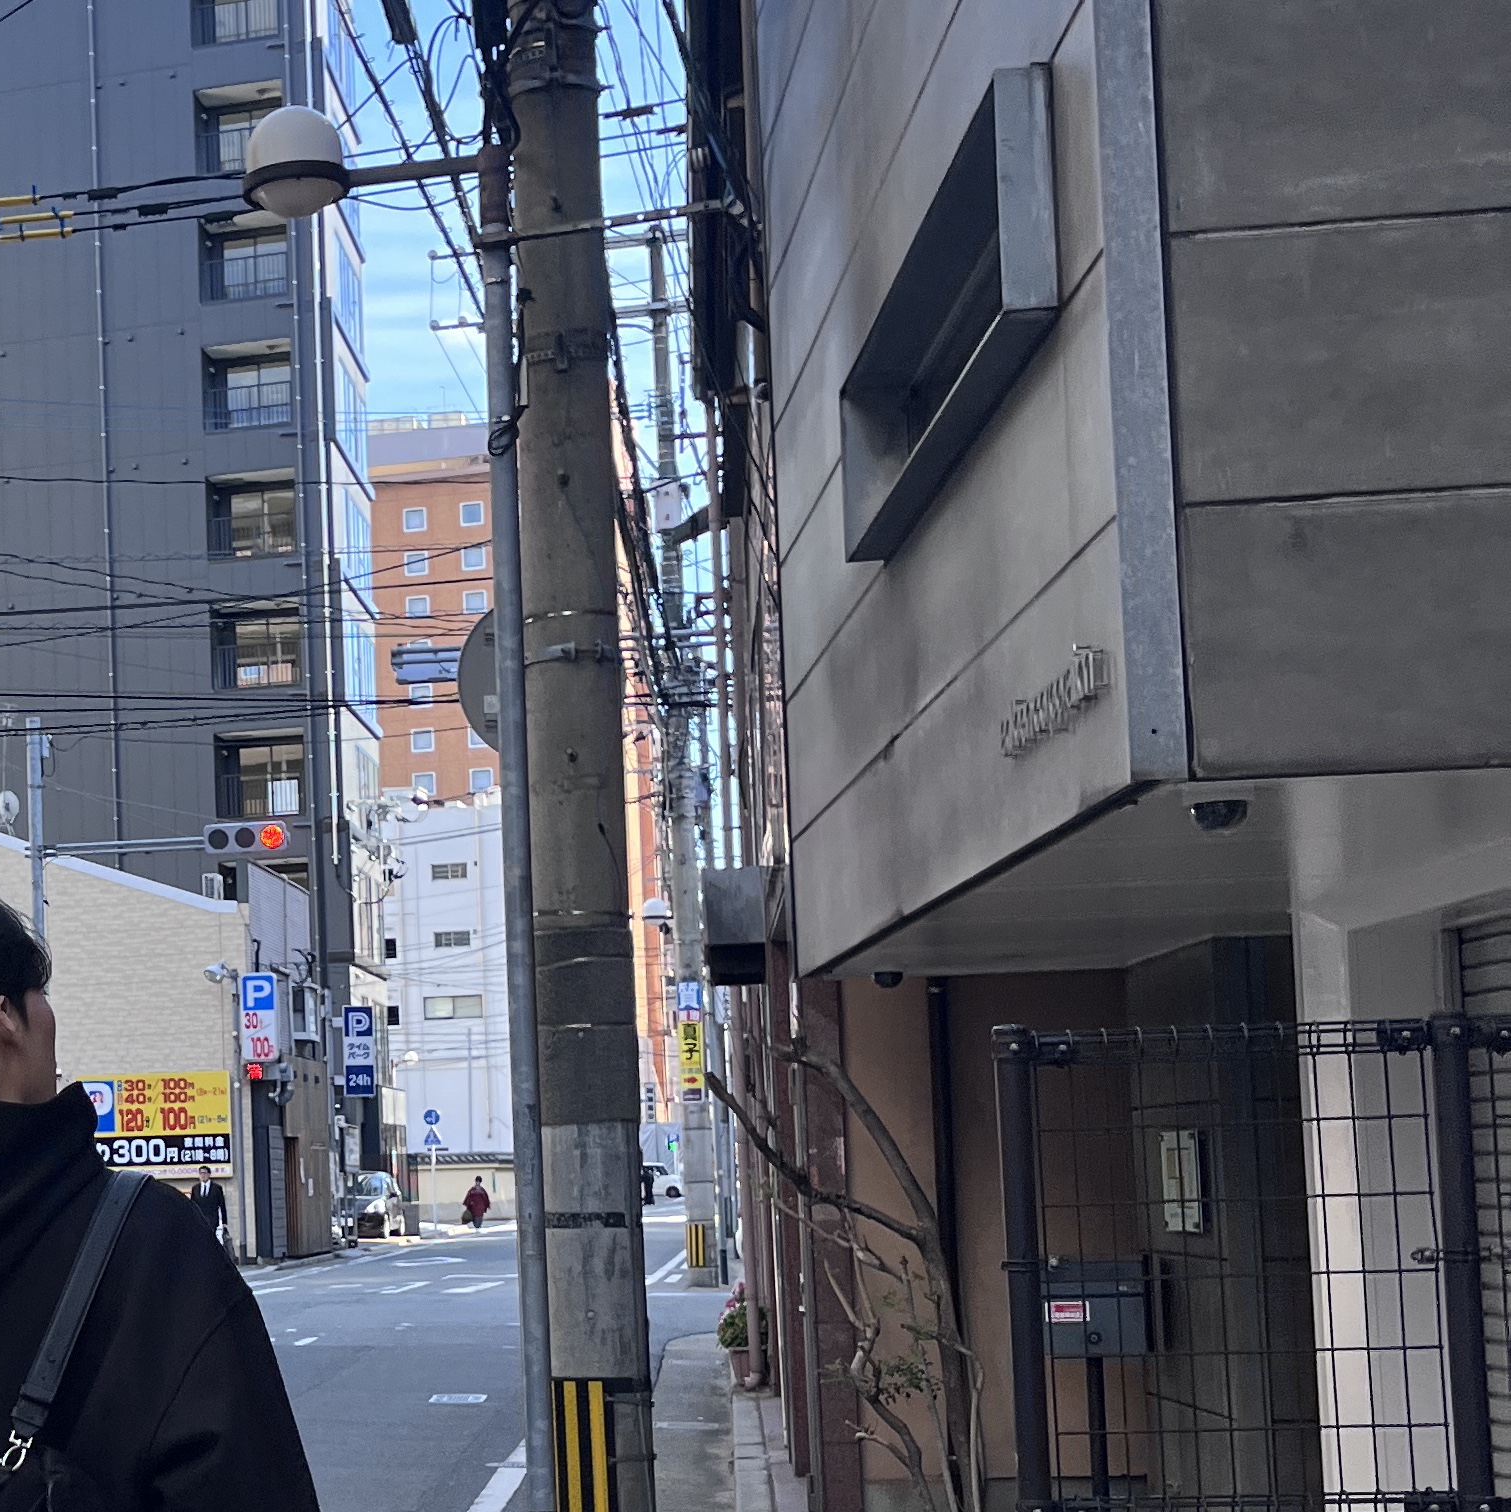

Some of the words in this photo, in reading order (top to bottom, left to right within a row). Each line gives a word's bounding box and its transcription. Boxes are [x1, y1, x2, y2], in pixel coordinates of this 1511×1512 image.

[246, 980, 271, 1008] P
[348, 1012, 370, 1037] P
[348, 1043, 370, 1051] タイム
[348, 1052, 370, 1060] パーク
[348, 1073, 371, 1087] 24h
